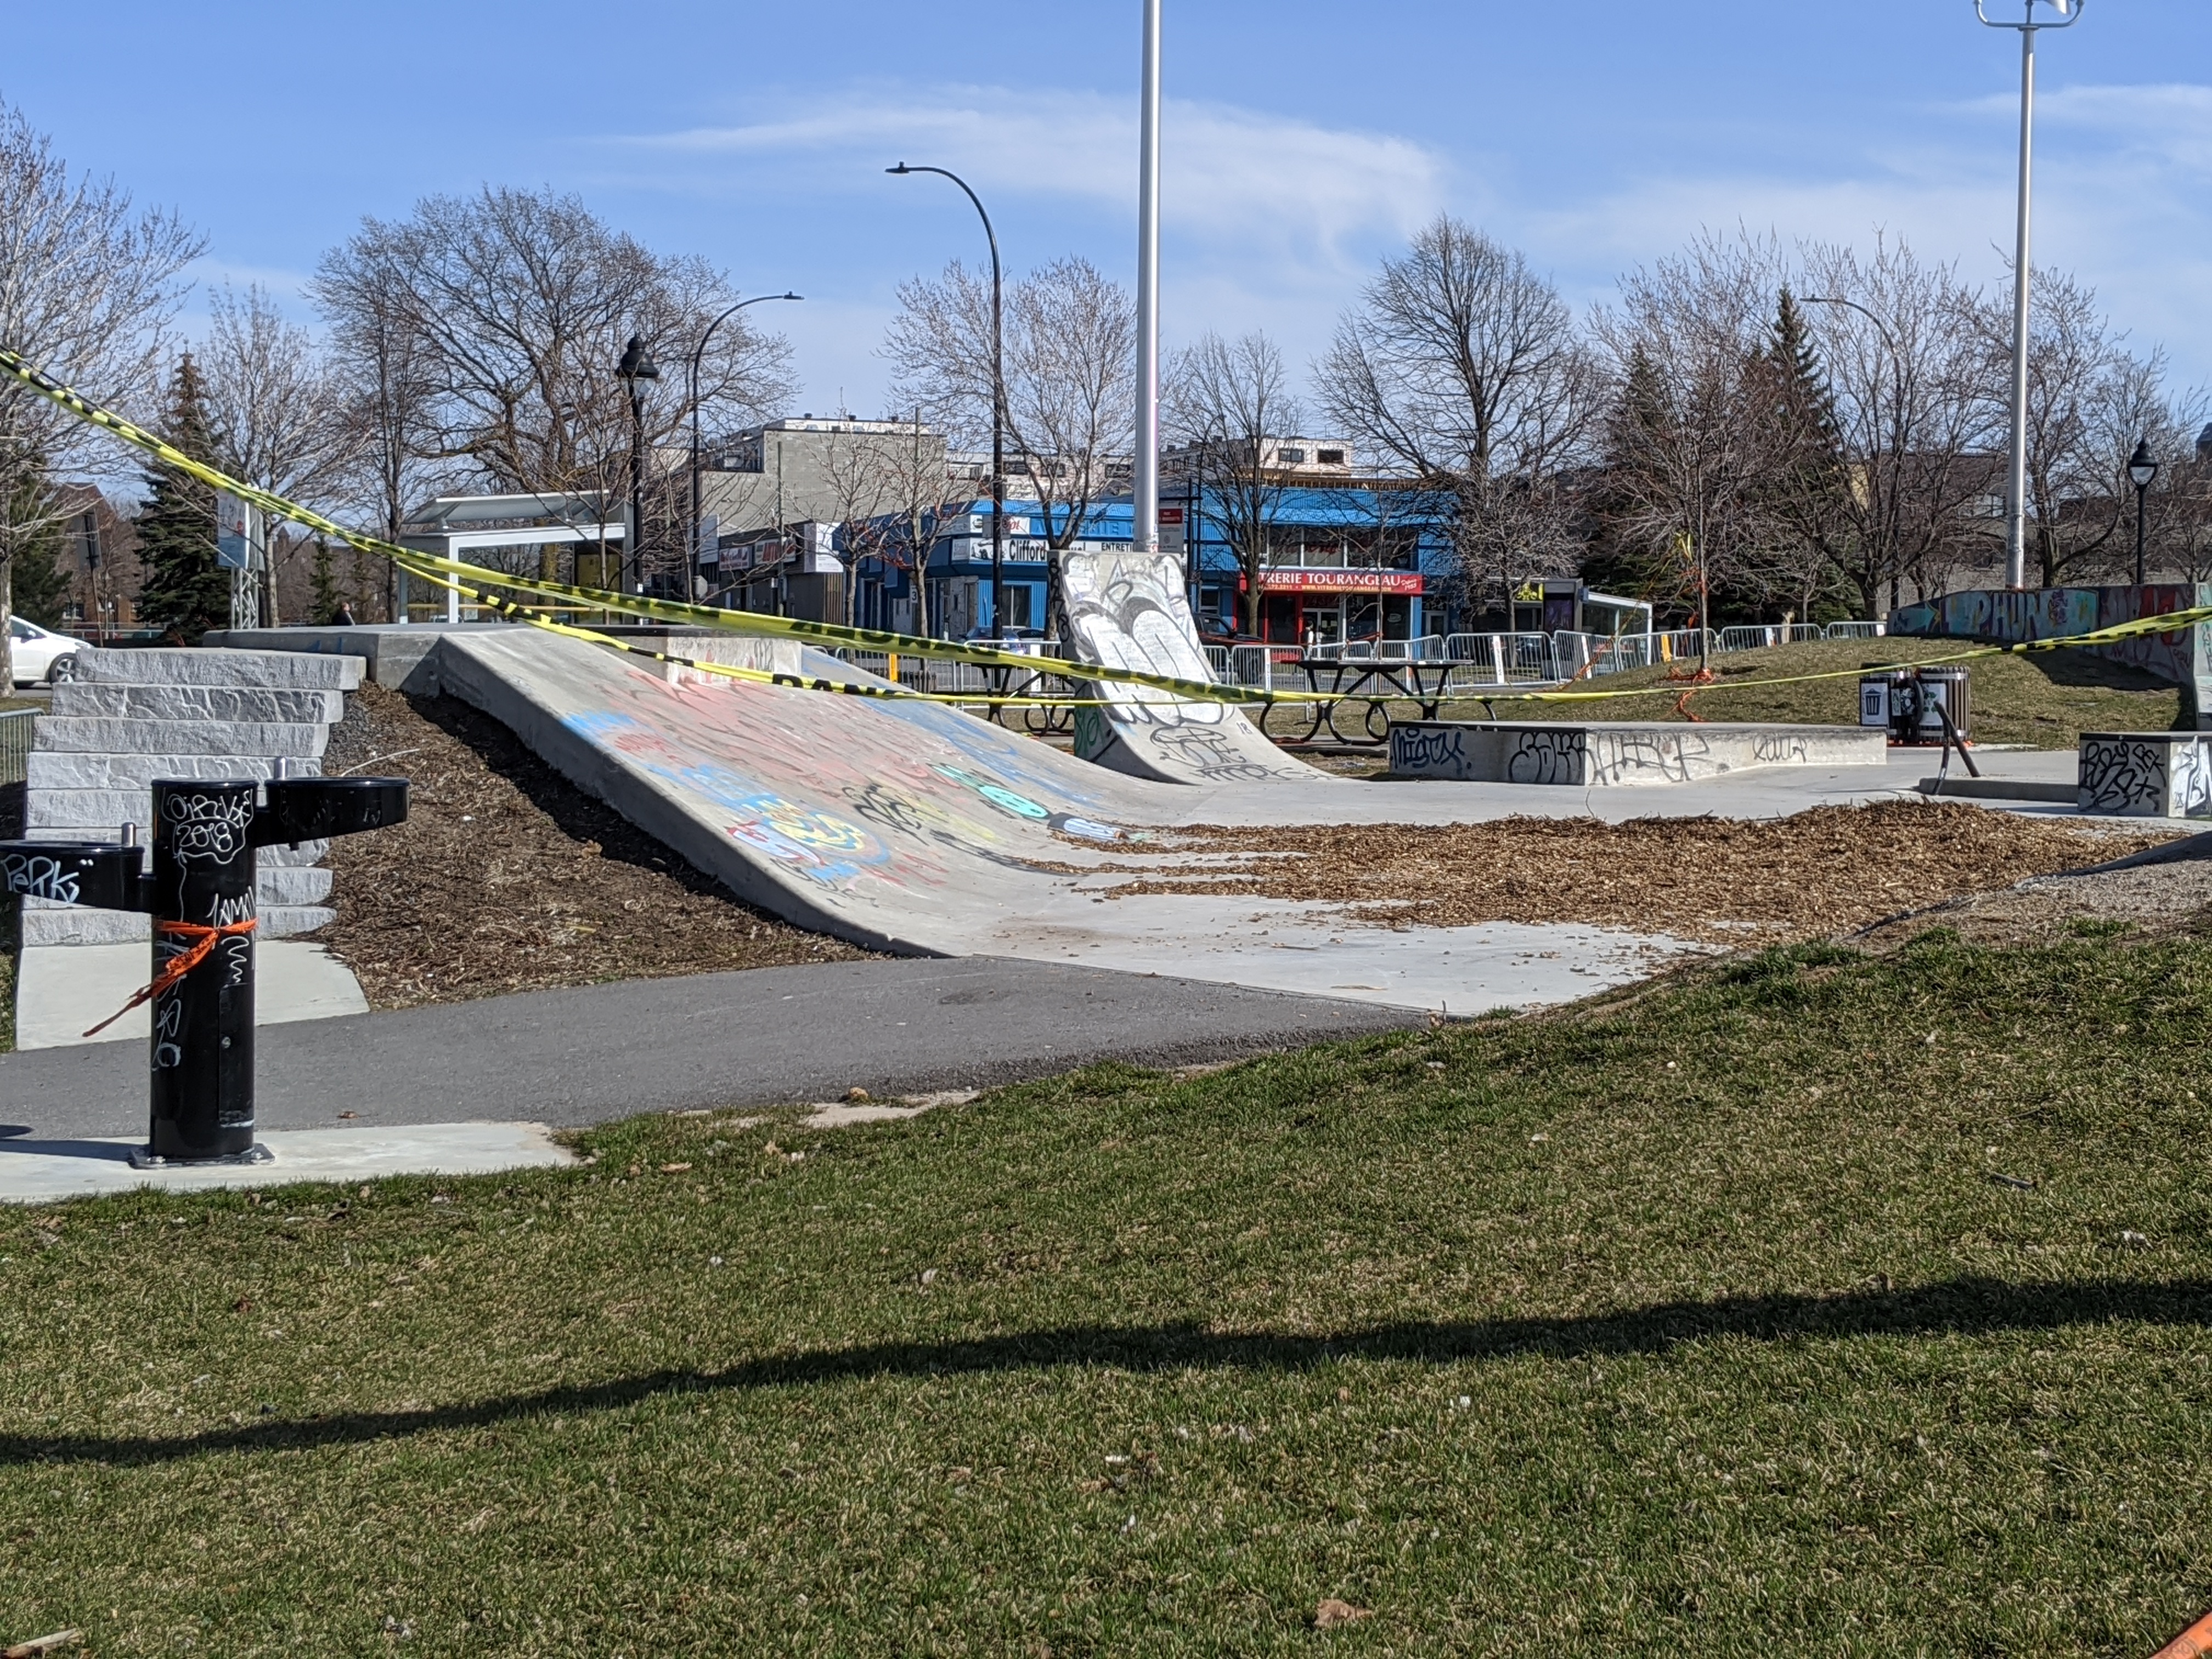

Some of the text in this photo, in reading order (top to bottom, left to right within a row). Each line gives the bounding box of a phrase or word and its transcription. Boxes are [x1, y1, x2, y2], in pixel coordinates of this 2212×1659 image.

[1009, 539, 1046, 561] Clifford
[1101, 542, 1132, 552] ENTRETI
[1258, 572, 1401, 586] TRERIE TOURANGEAU
